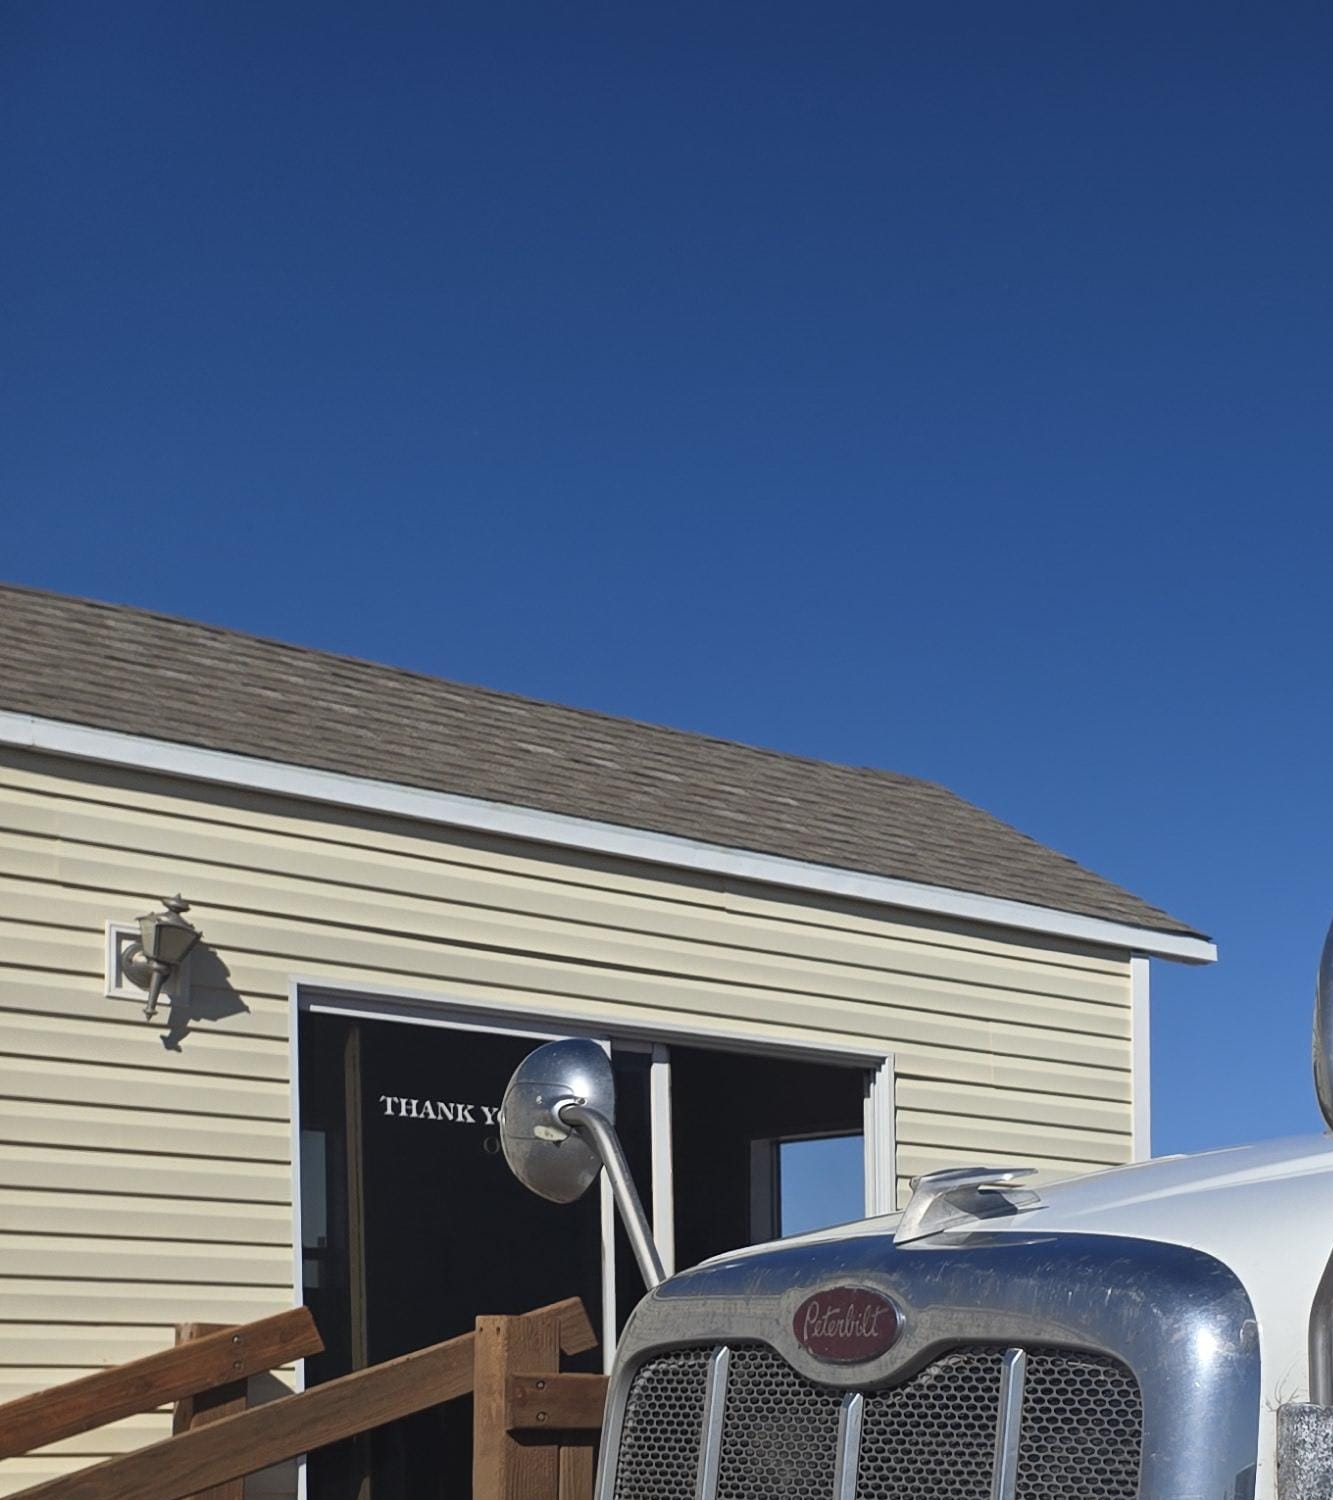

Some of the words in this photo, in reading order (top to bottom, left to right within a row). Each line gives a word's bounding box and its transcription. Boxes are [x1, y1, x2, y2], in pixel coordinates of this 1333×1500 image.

[379, 1095, 477, 1124] THANK
[480, 1105, 501, 1125] Y
[803, 1301, 889, 1342] Peterbilt
